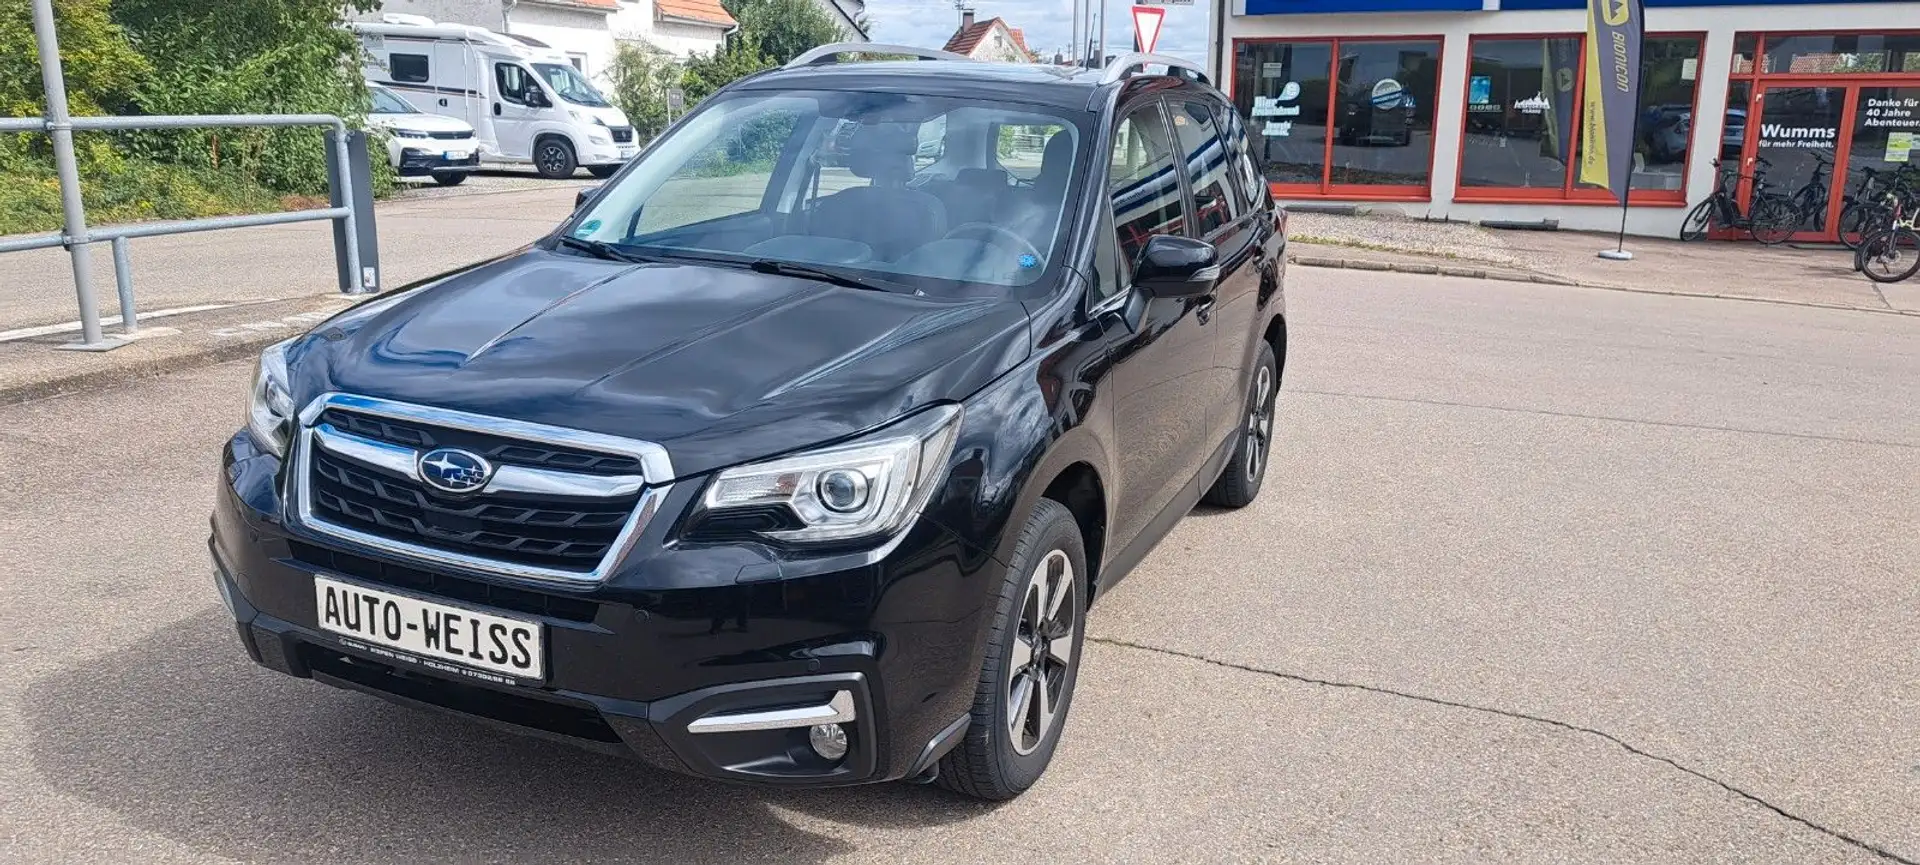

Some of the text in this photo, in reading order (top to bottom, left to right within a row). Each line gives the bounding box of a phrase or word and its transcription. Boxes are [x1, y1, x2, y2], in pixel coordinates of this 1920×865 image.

[1611, 31, 1629, 93] BIONICON
[1868, 97, 1919, 107] Danke für
[1866, 108, 1911, 117] 40 Jahre
[1760, 123, 1836, 139] Wumms
[1758, 140, 1834, 148] für mehr Freiheit.
[325, 586, 531, 669] AUTO-WEISS
